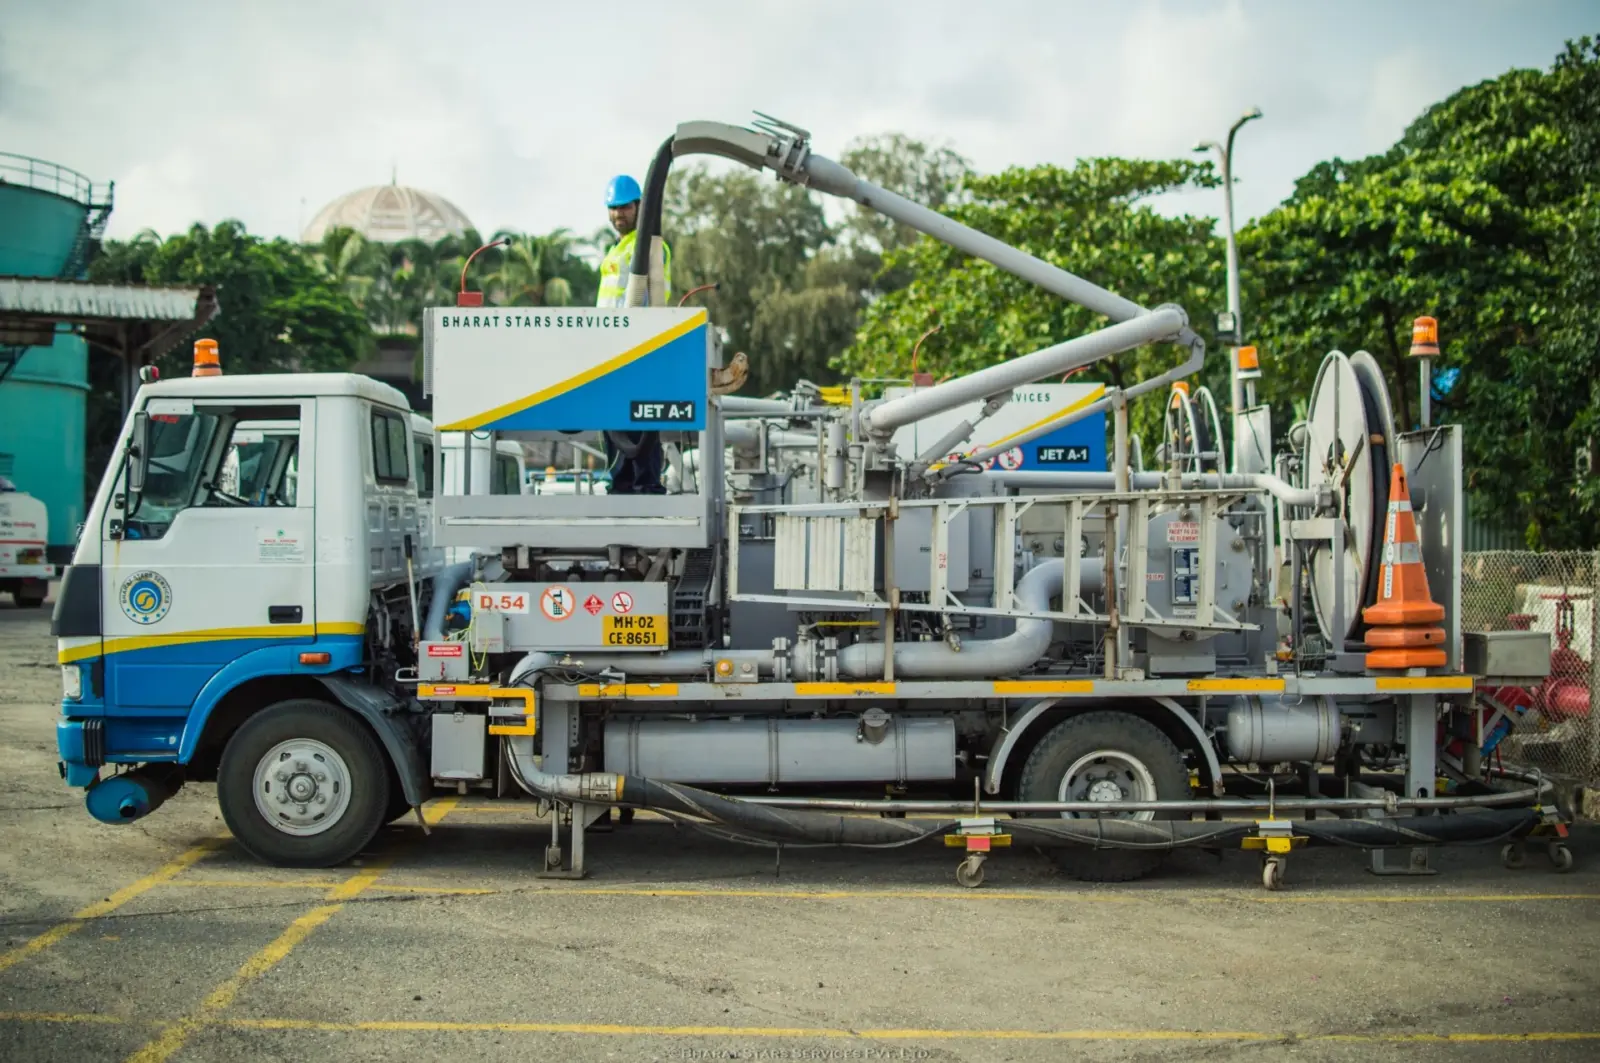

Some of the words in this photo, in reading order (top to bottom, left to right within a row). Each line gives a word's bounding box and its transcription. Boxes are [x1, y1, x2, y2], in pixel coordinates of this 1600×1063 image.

[442, 315, 499, 328] BHARAT
[505, 315, 551, 328] STARS
[557, 315, 630, 328] SERVICES
[633, 404, 664, 418] JET
[668, 404, 693, 418] A-1
[1040, 449, 1064, 461] JET
[1068, 448, 1088, 460] A-1
[480, 595, 524, 610] D.54
[614, 616, 654, 629] MH-02
[609, 632, 657, 645] CE-8651
